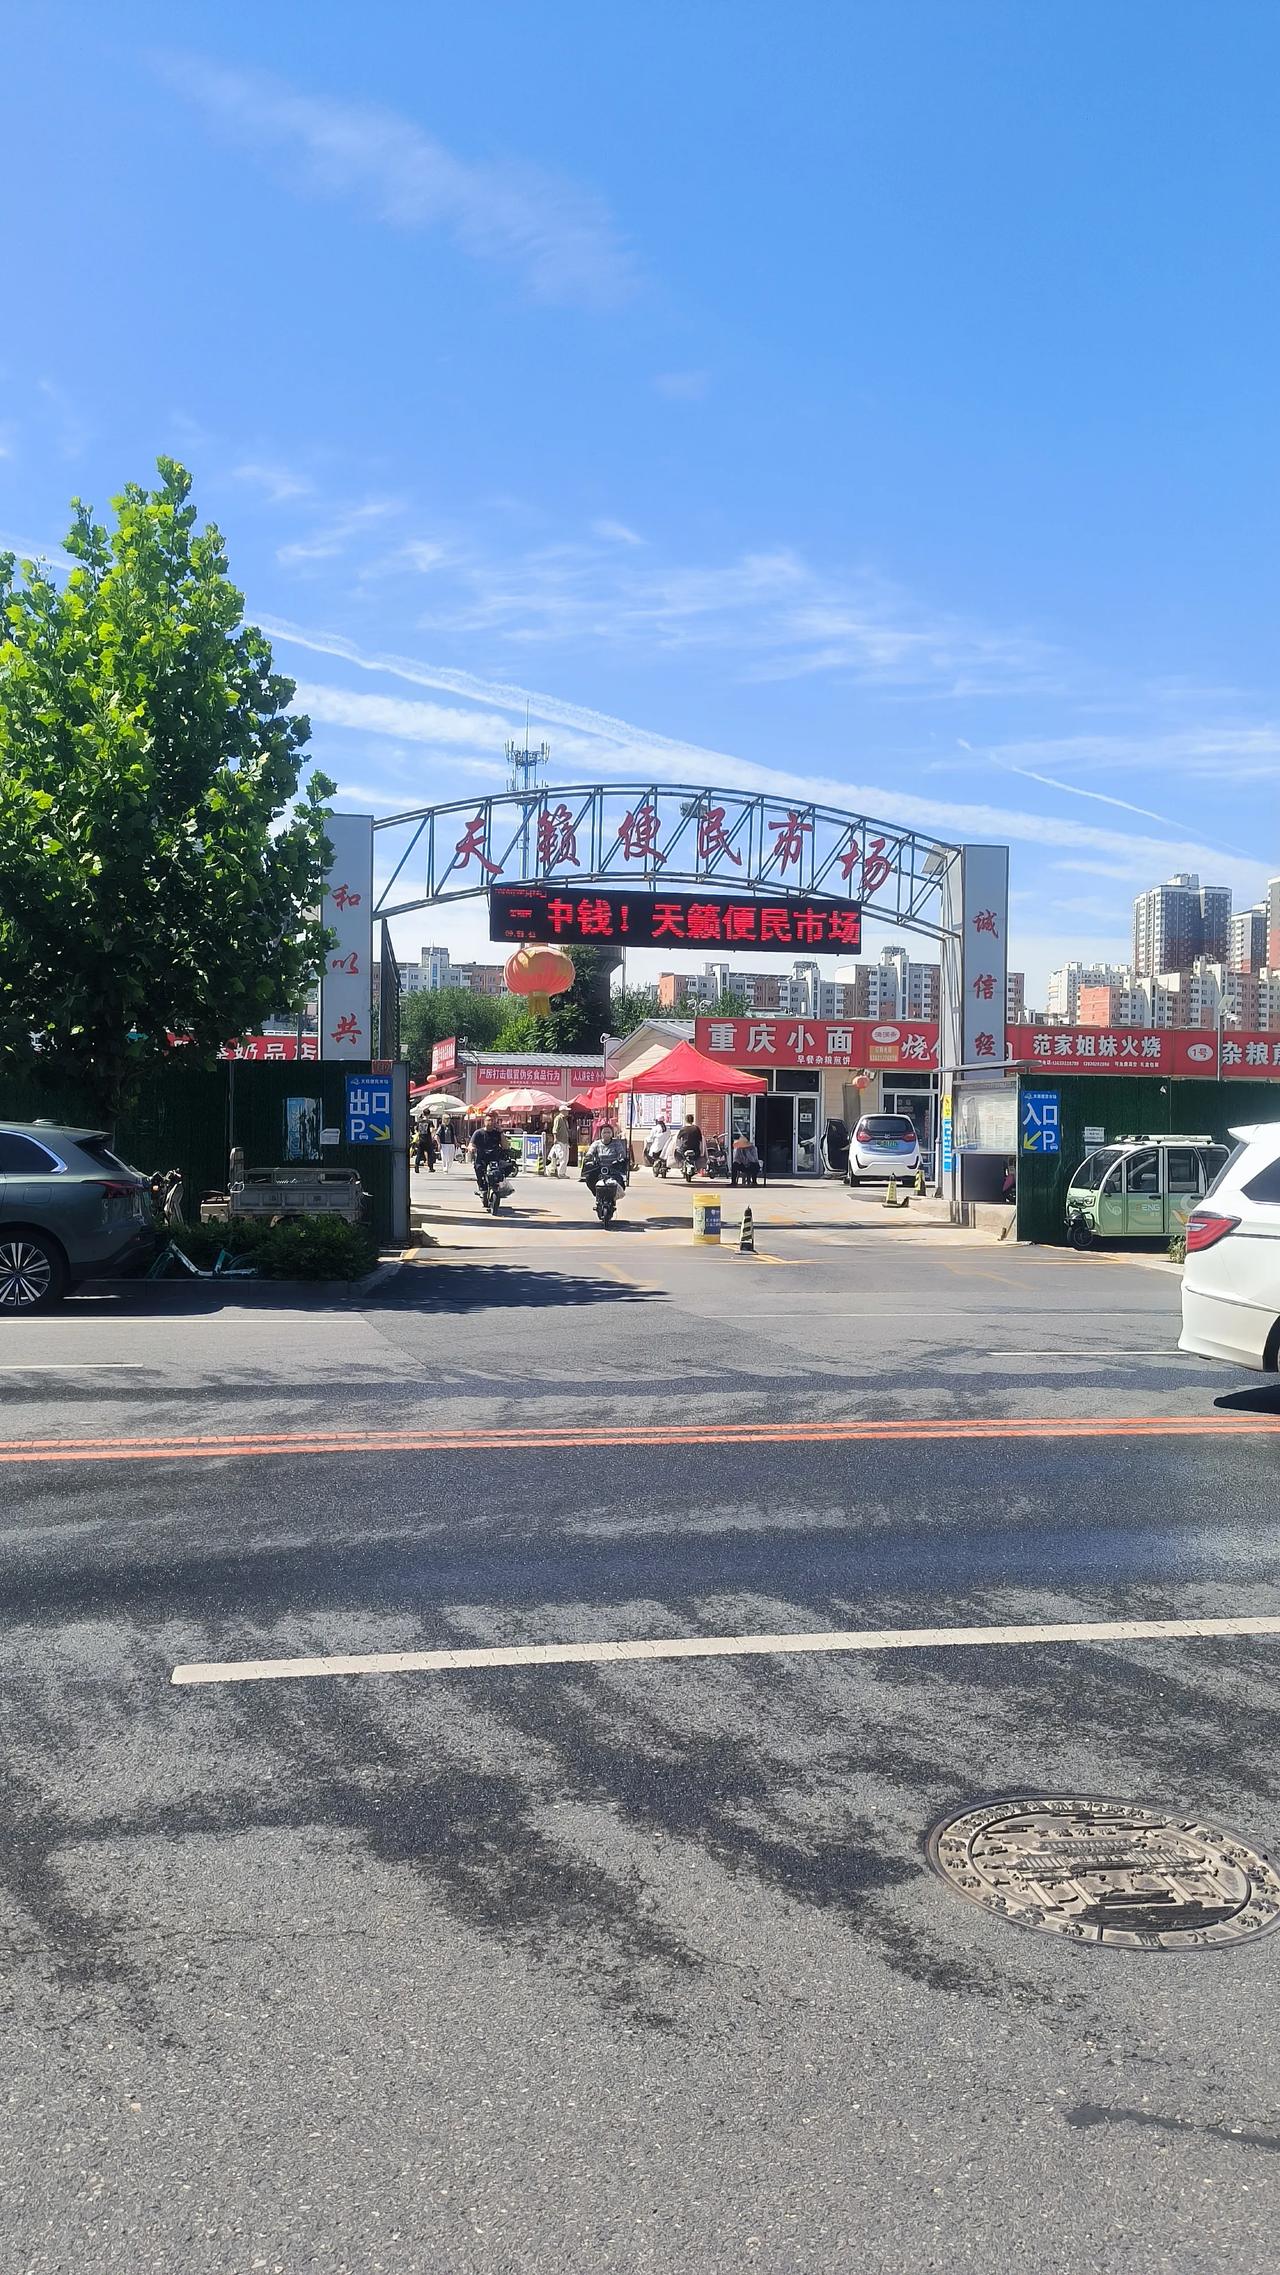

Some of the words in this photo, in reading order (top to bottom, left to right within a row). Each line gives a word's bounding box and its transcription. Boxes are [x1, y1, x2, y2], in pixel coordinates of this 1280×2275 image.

[453, 803, 891, 892] 天籁便民市场
[707, 1024, 855, 1053] 重庆小面
[1033, 1034, 1161, 1057] 范家姐妹火烧
[797, 1055, 851, 1065] 早餐杂粮煎饼
[1192, 1048, 1208, 1058] 1号
[349, 1089, 390, 1115] 出口
[1022, 1102, 1058, 1126] 入口
